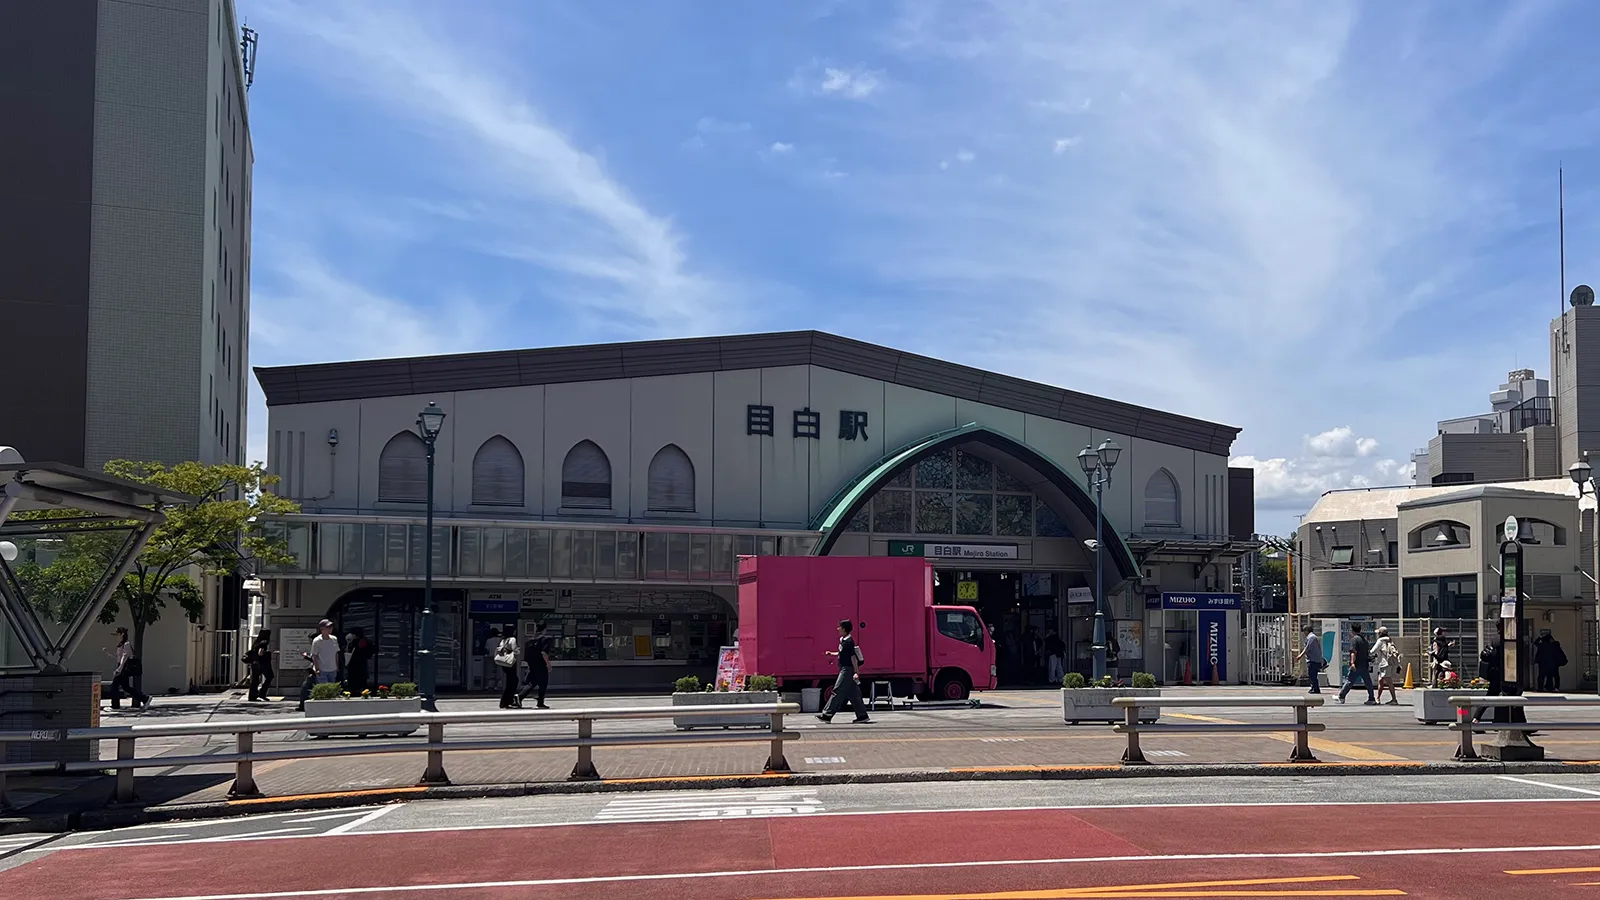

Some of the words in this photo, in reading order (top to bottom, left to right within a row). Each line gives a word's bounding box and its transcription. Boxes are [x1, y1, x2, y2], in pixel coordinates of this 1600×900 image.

[747, 404, 868, 441] 目白駅
[902, 545, 914, 553] JR
[934, 546, 961, 556] 目白駅
[964, 549, 984, 558] Mejiro
[1210, 621, 1218, 665] MIZUHO
